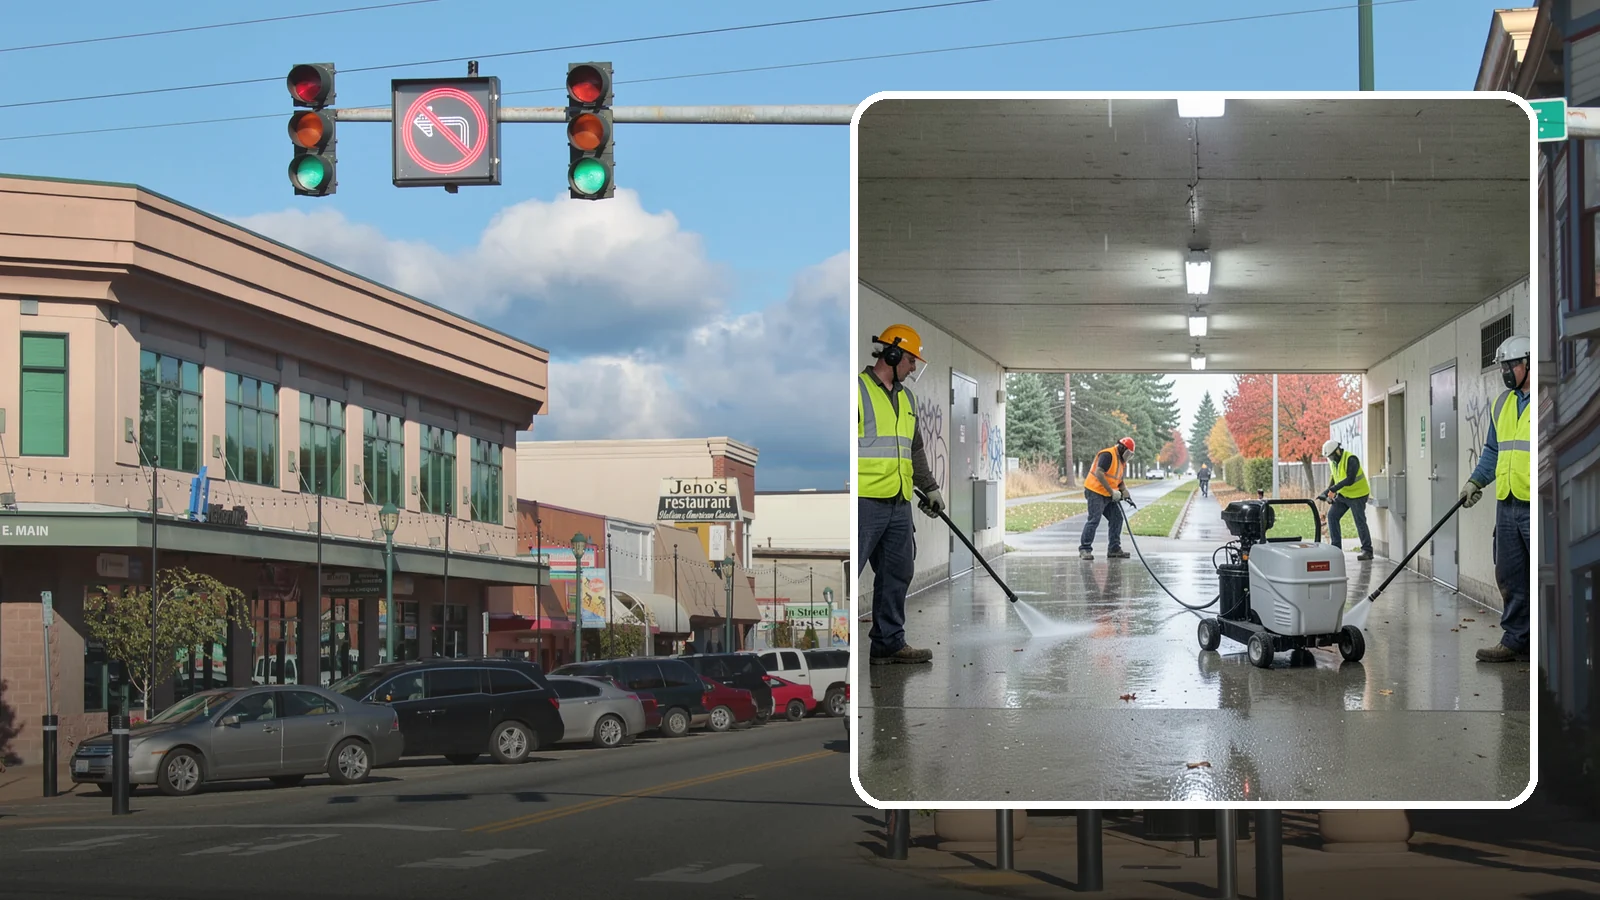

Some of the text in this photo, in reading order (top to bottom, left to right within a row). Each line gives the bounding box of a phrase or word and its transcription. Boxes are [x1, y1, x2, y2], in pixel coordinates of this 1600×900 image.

[670, 480, 728, 494] Jeno's
[665, 496, 731, 509] restaurant
[658, 510, 681, 519] Italian
[686, 509, 714, 519] American
[715, 509, 737, 519] Cuisine
[2, 525, 49, 536] E. MAIN
[797, 607, 828, 617] Street
